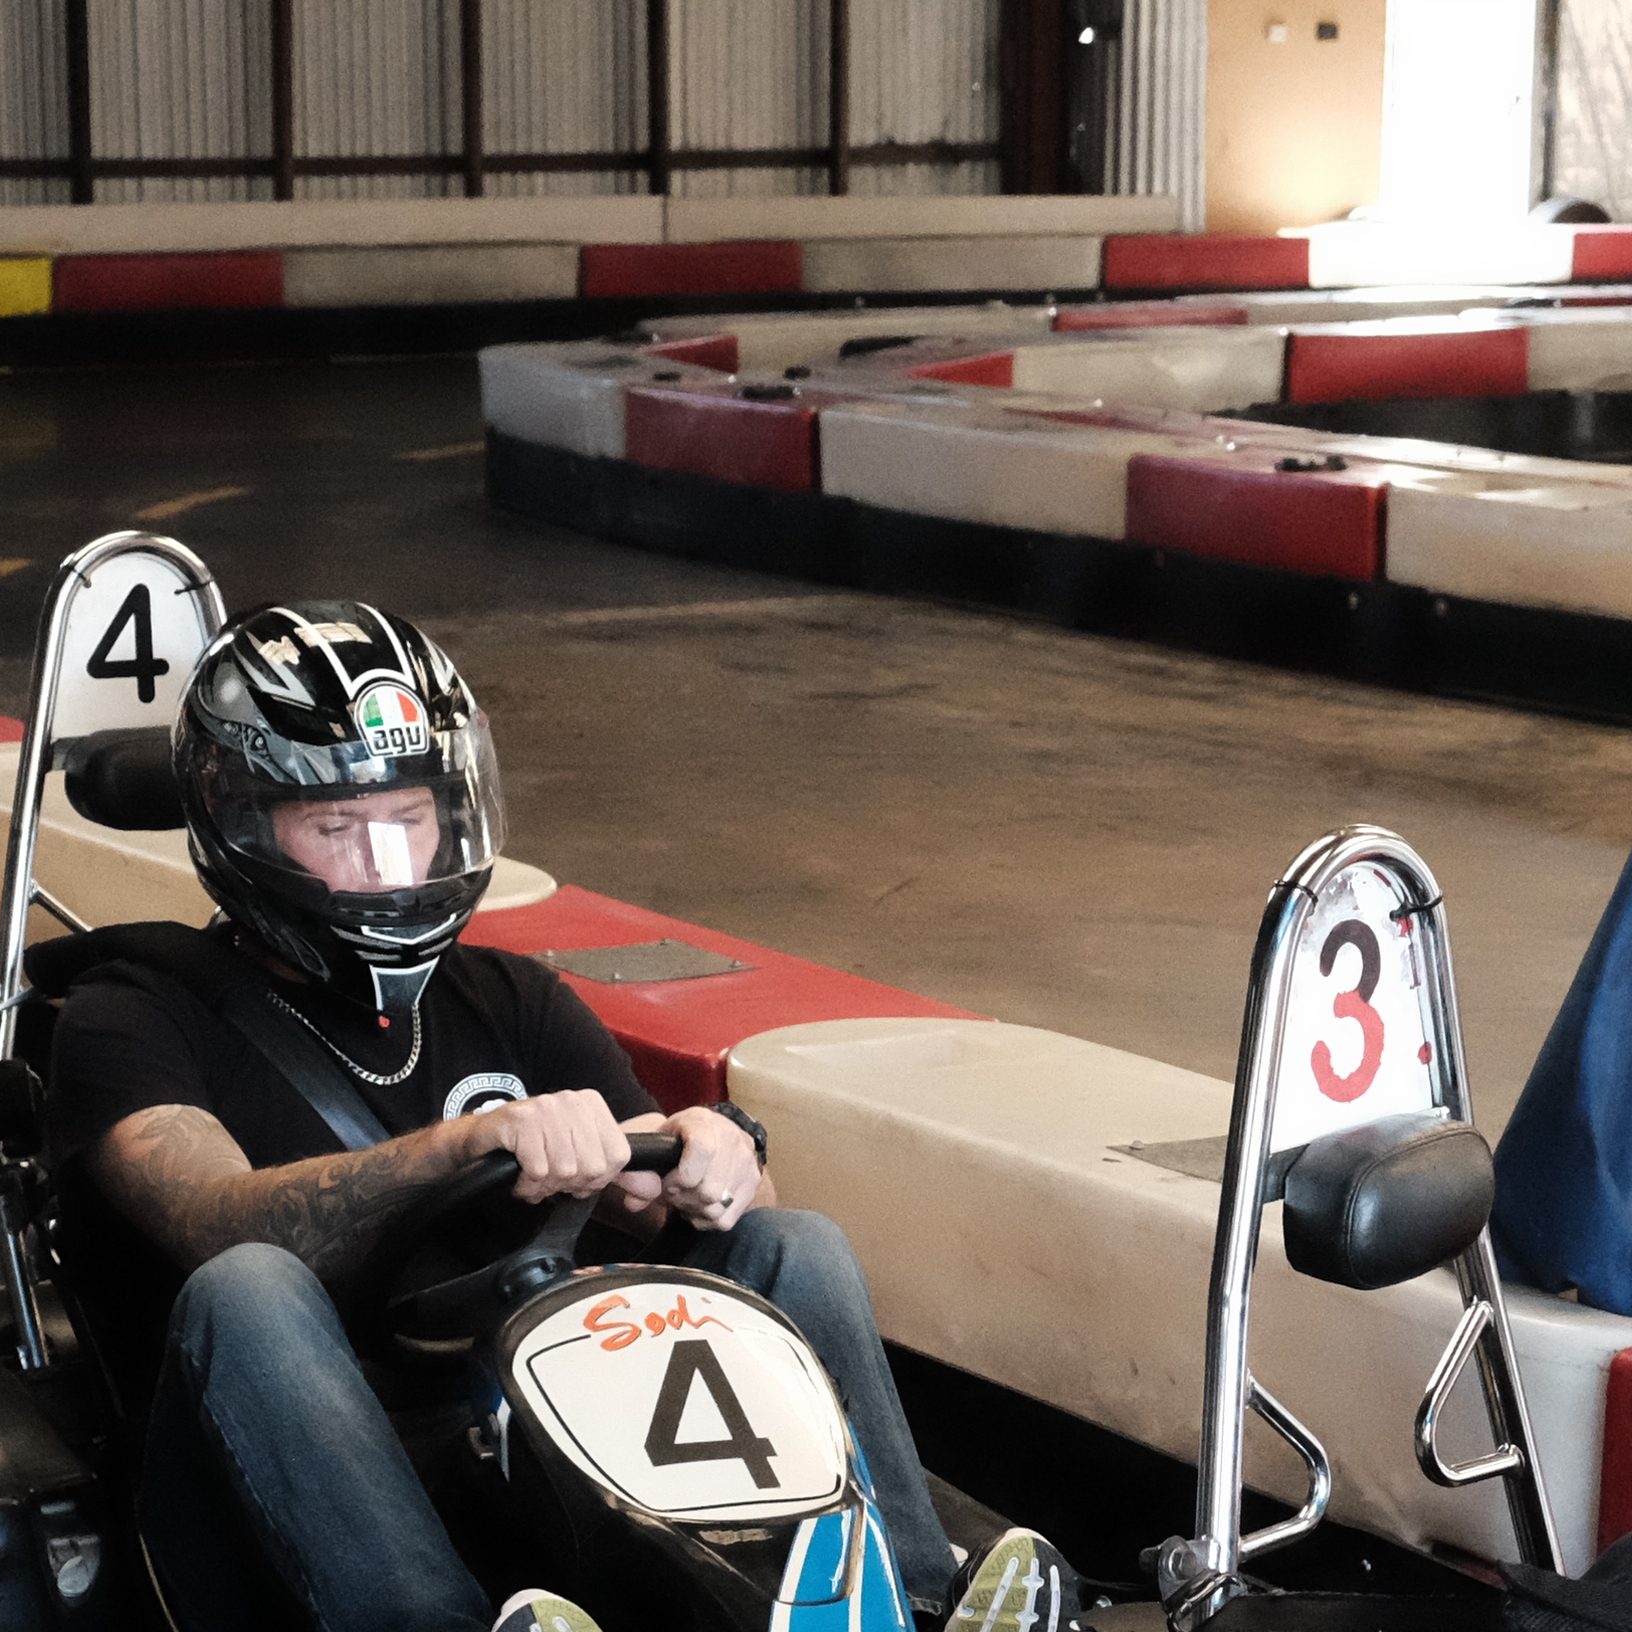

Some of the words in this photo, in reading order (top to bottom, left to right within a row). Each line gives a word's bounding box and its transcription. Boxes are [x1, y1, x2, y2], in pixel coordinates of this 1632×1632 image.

[86, 583, 170, 703] 4
[373, 726, 421, 755] agv
[1310, 919, 1385, 1103] 3
[582, 1294, 734, 1351] Sodi
[644, 1338, 780, 1490] 4
